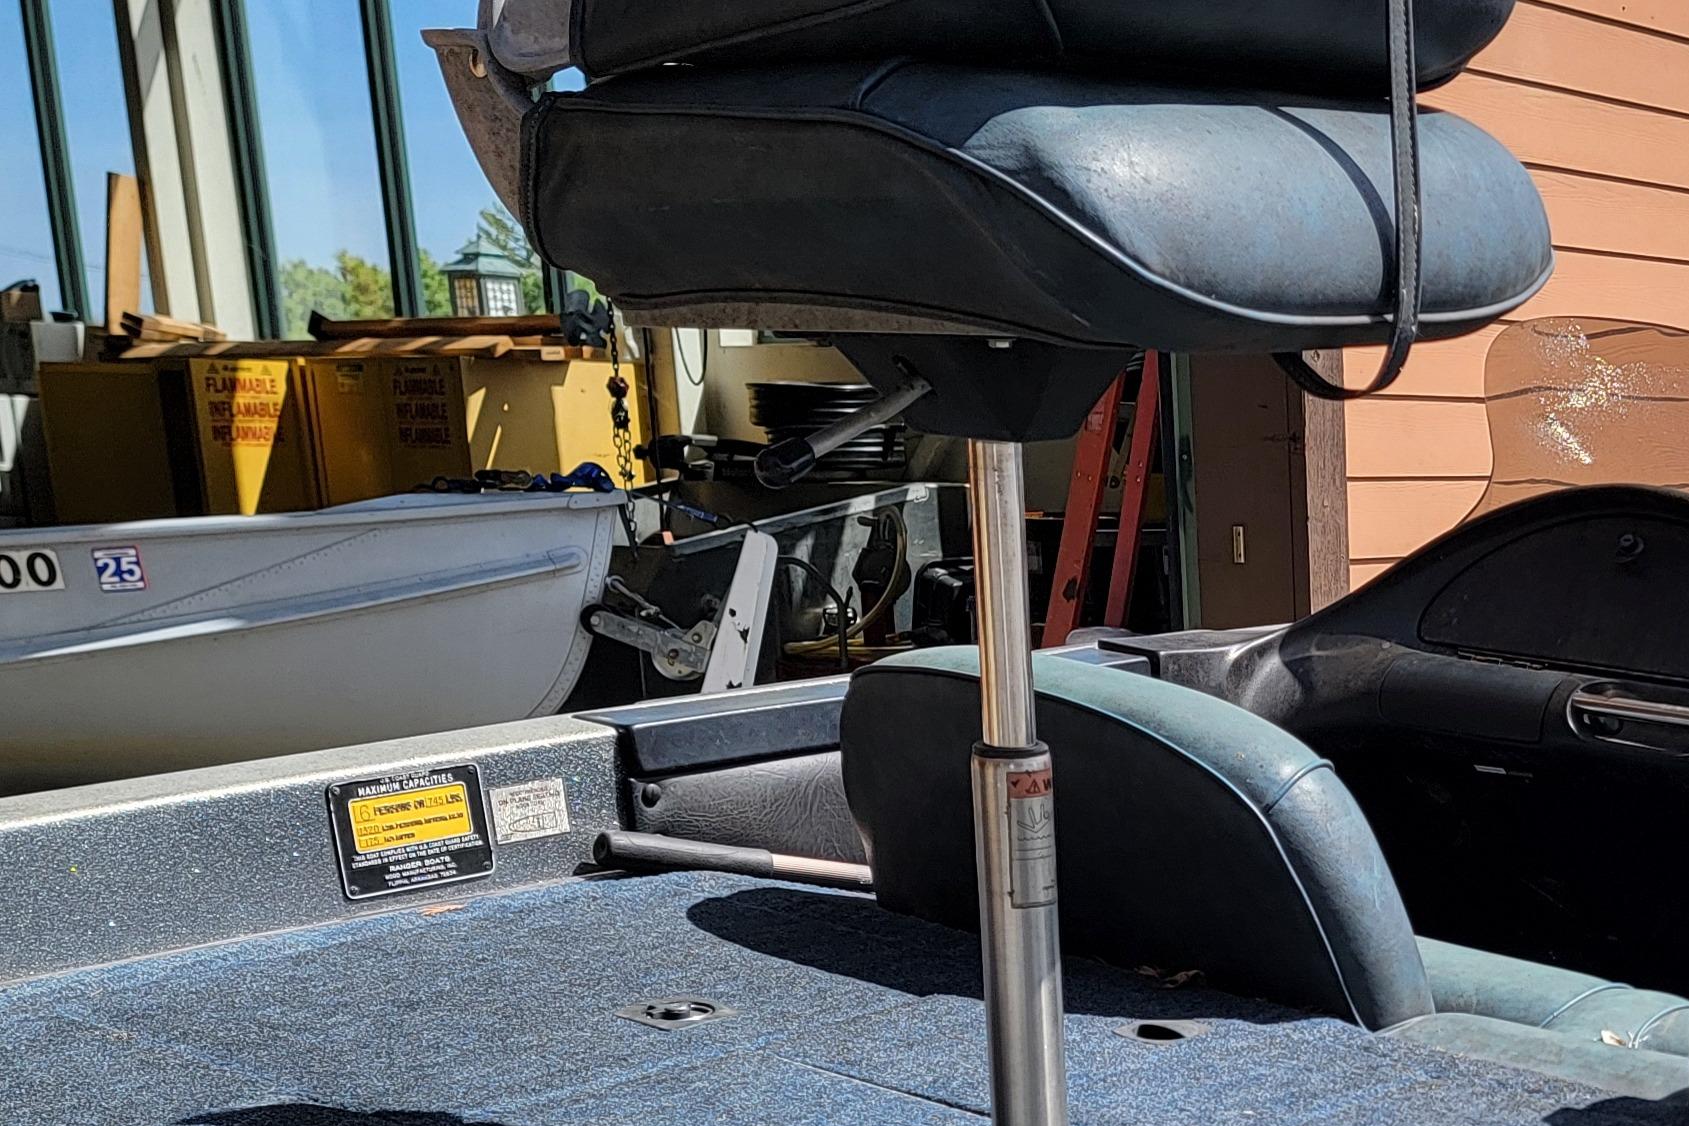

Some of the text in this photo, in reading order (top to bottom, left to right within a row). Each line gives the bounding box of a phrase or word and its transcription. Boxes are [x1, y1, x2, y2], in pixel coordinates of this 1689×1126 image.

[96, 556, 142, 584] 25
[357, 773, 454, 797] MAXIMUM CAPACITIES
